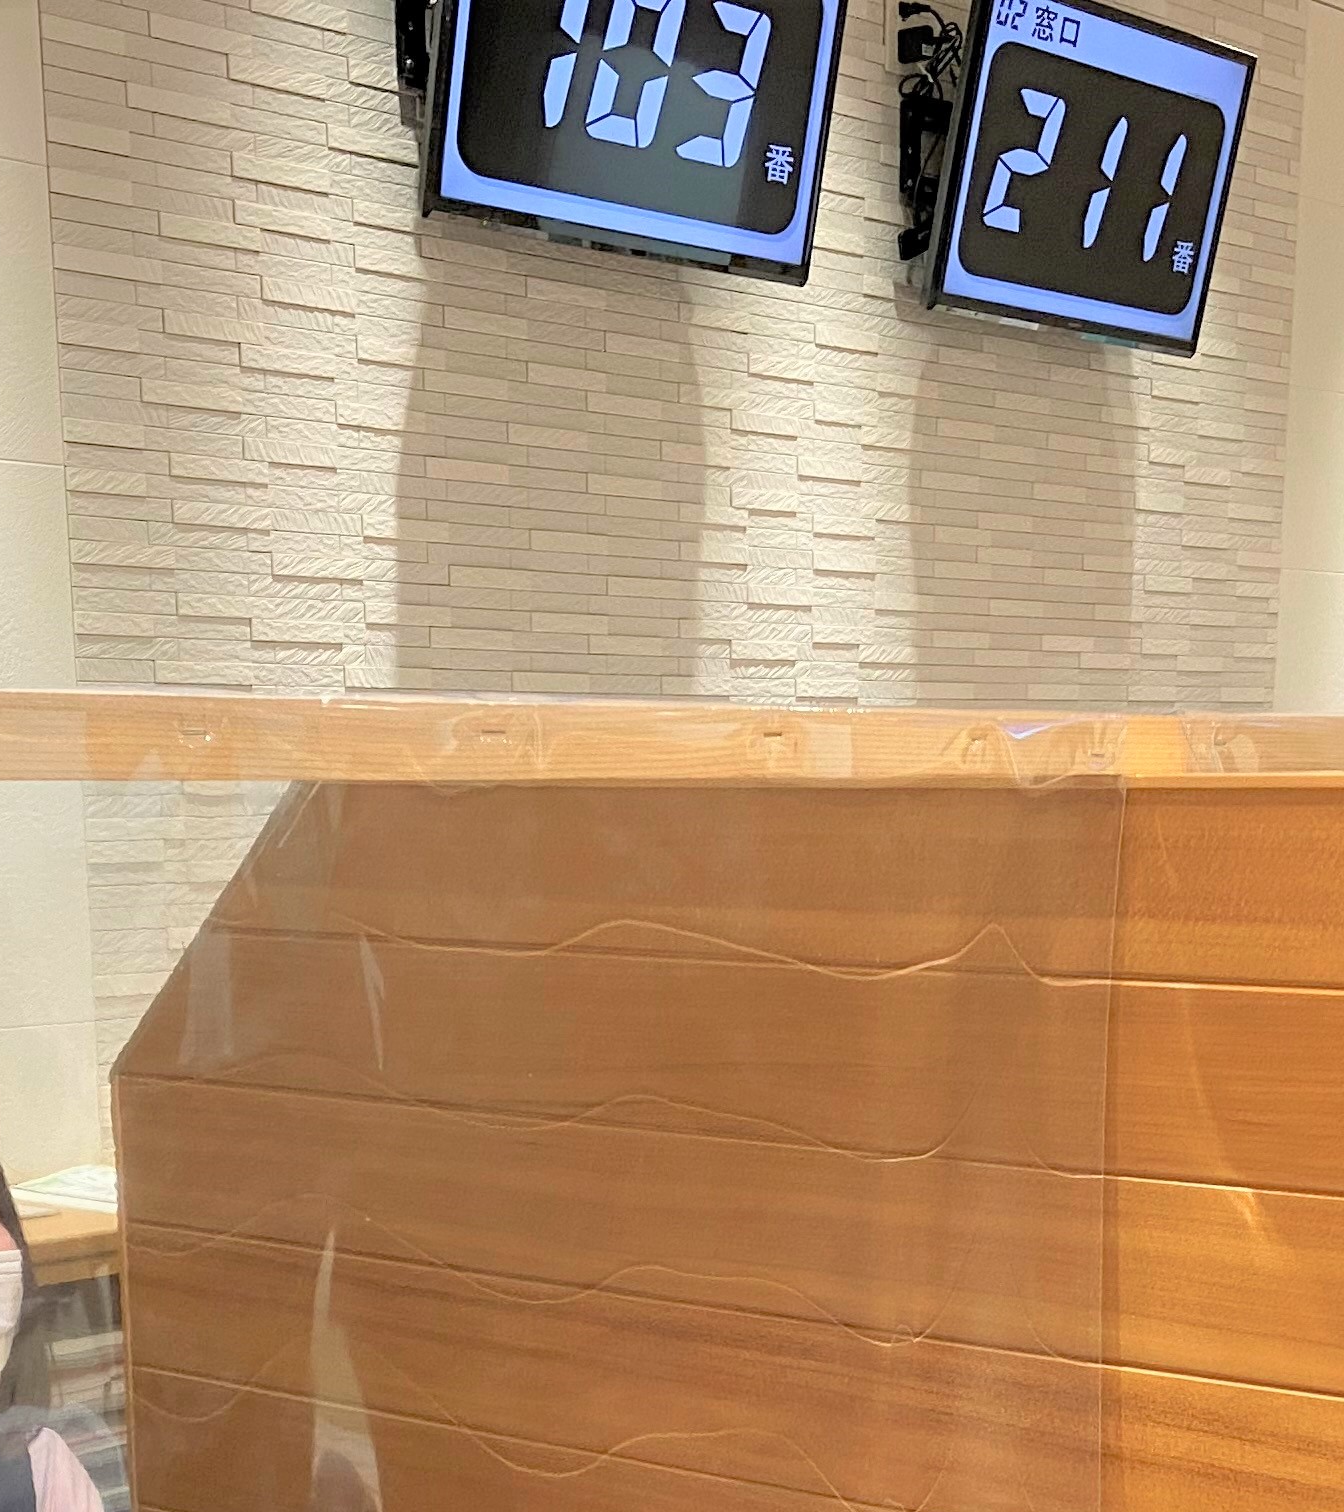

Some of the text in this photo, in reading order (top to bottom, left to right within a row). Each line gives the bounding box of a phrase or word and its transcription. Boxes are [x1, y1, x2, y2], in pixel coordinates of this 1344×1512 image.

[543, 0, 771, 168] 103
[764, 143, 794, 185] 番
[982, 88, 1188, 262] 211
[1172, 240, 1194, 274] 番
